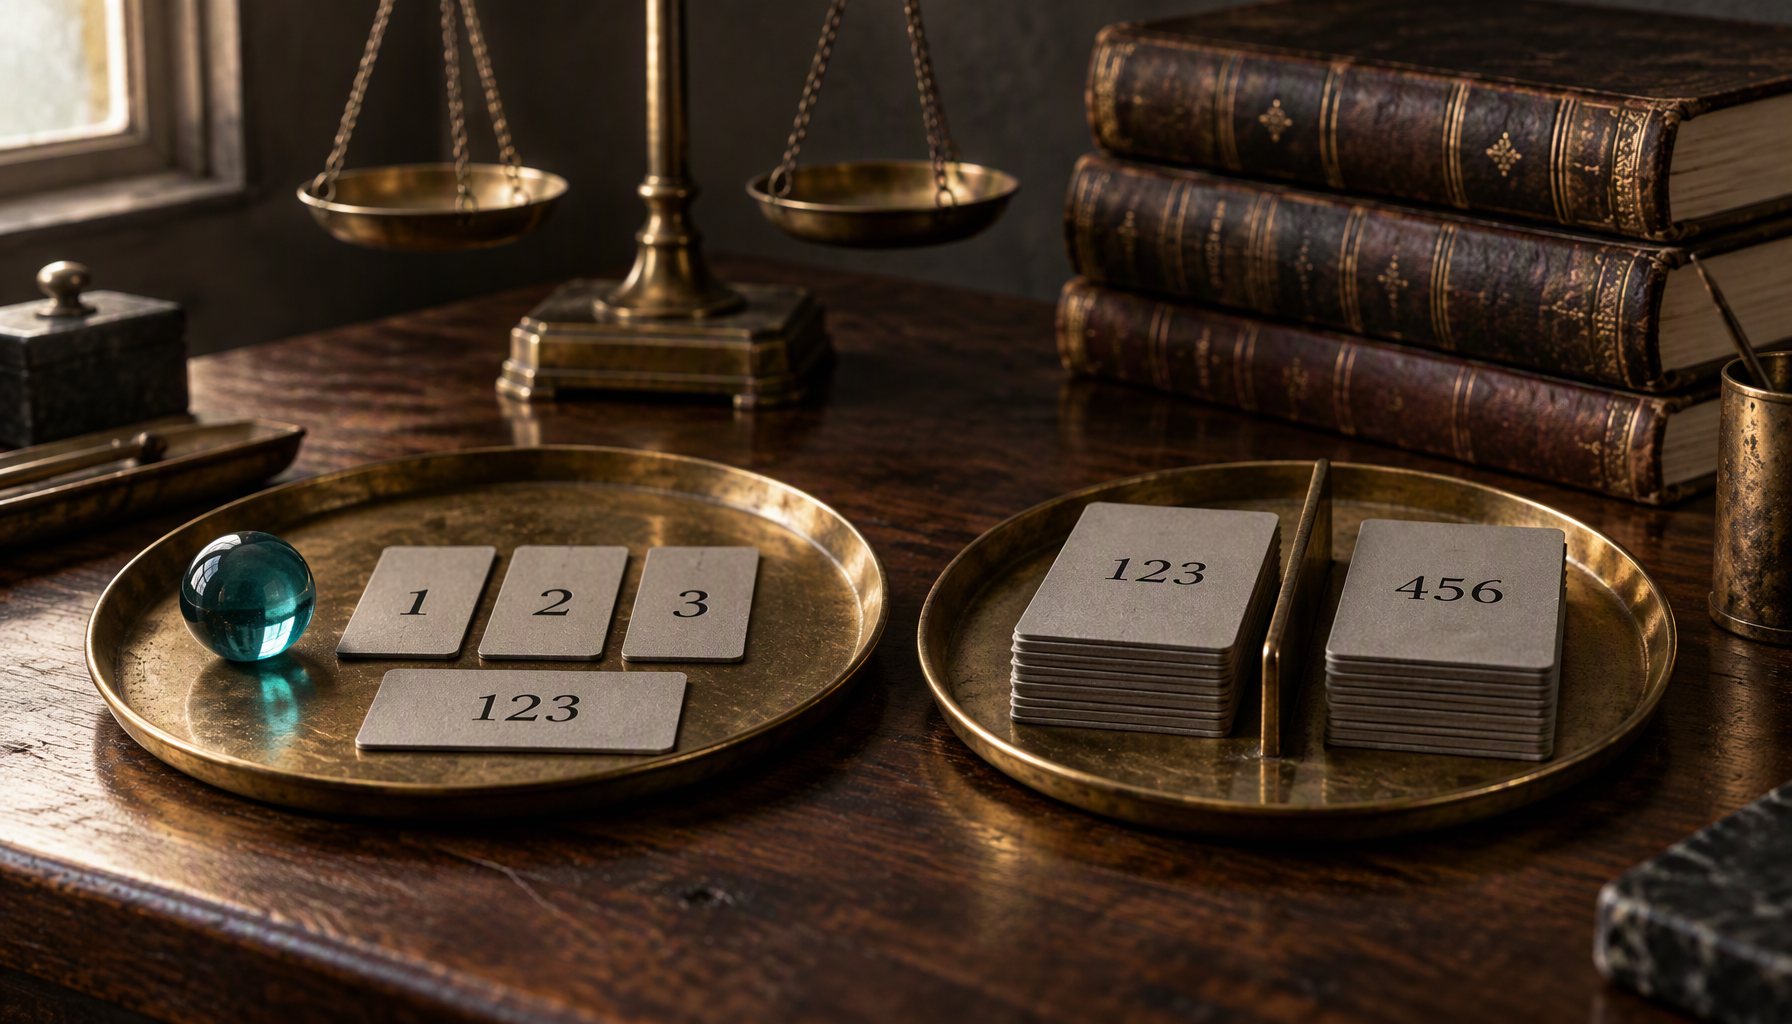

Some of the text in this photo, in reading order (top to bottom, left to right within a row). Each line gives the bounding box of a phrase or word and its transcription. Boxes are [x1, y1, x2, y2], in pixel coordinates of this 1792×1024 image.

[1104, 557, 1207, 586] 123
[399, 588, 430, 617] 1
[532, 588, 573, 617] 2
[672, 589, 709, 618] 3
[1394, 575, 1505, 604] 456
[471, 693, 580, 723] 123
